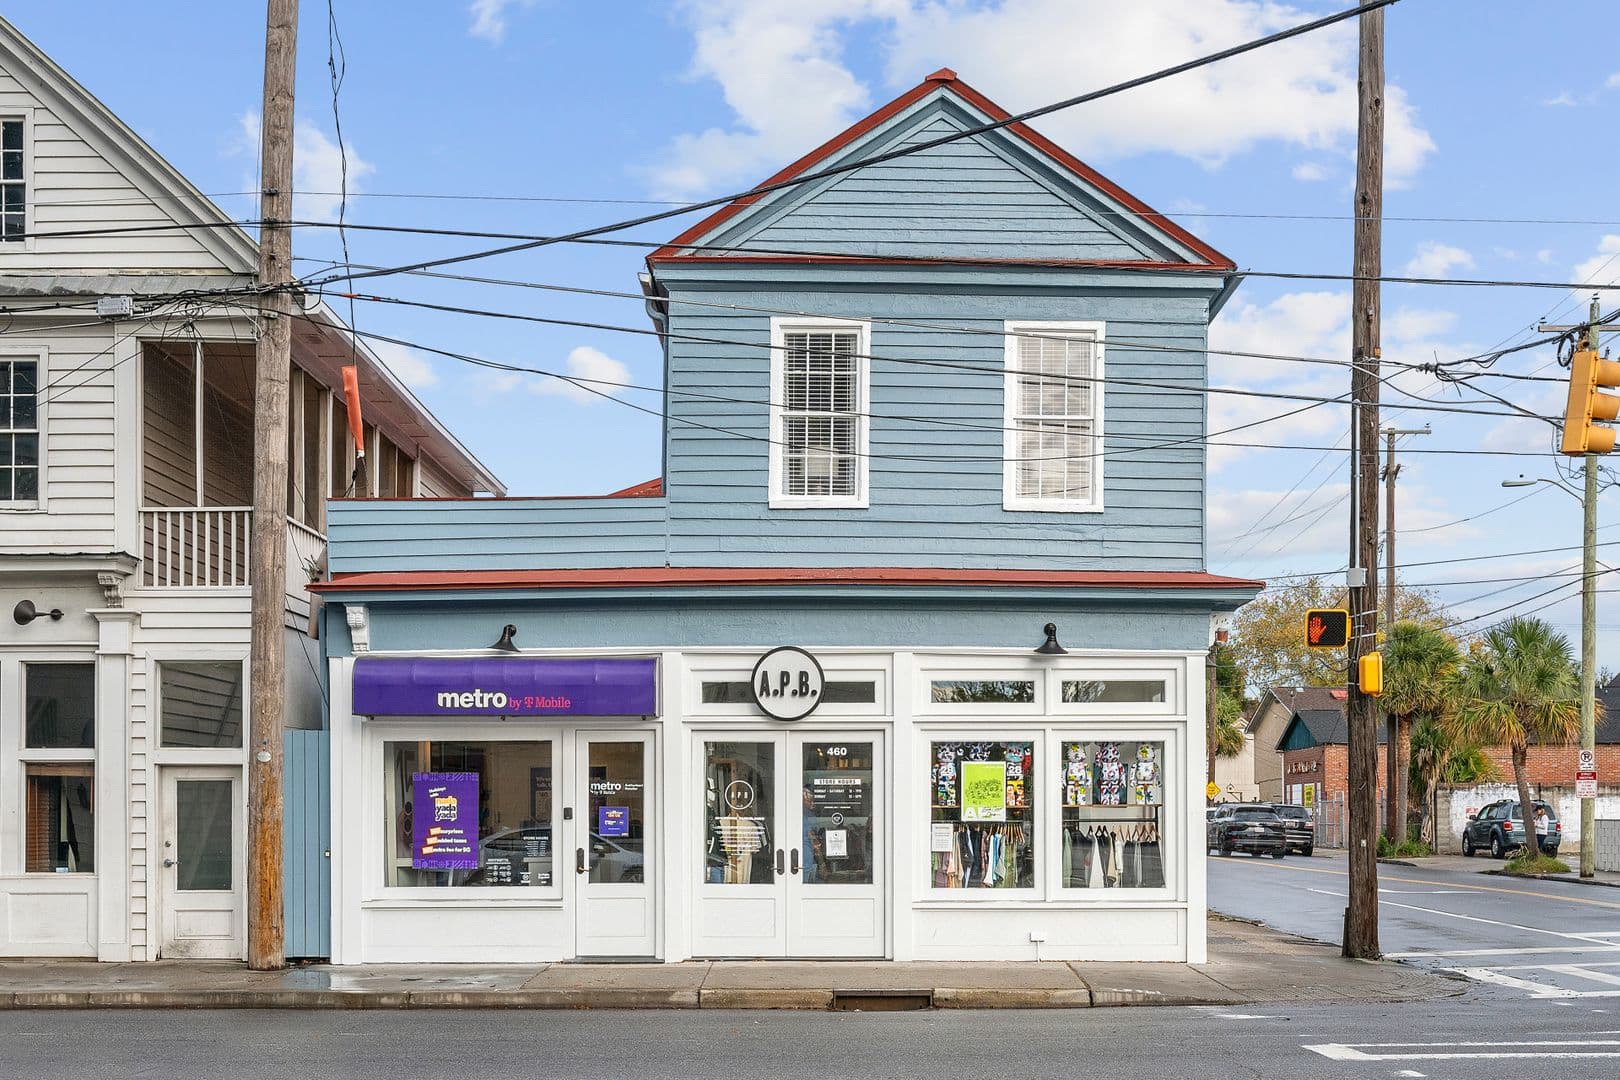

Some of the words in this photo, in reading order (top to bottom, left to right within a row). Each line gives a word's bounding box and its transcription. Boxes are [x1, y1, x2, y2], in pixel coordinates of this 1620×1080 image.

[759, 670, 818, 697] A.P.B.
[437, 688, 508, 709] metro
[509, 697, 522, 710] by
[535, 696, 571, 708] Mobile
[826, 746, 848, 756] 460
[590, 781, 622, 791] metro
